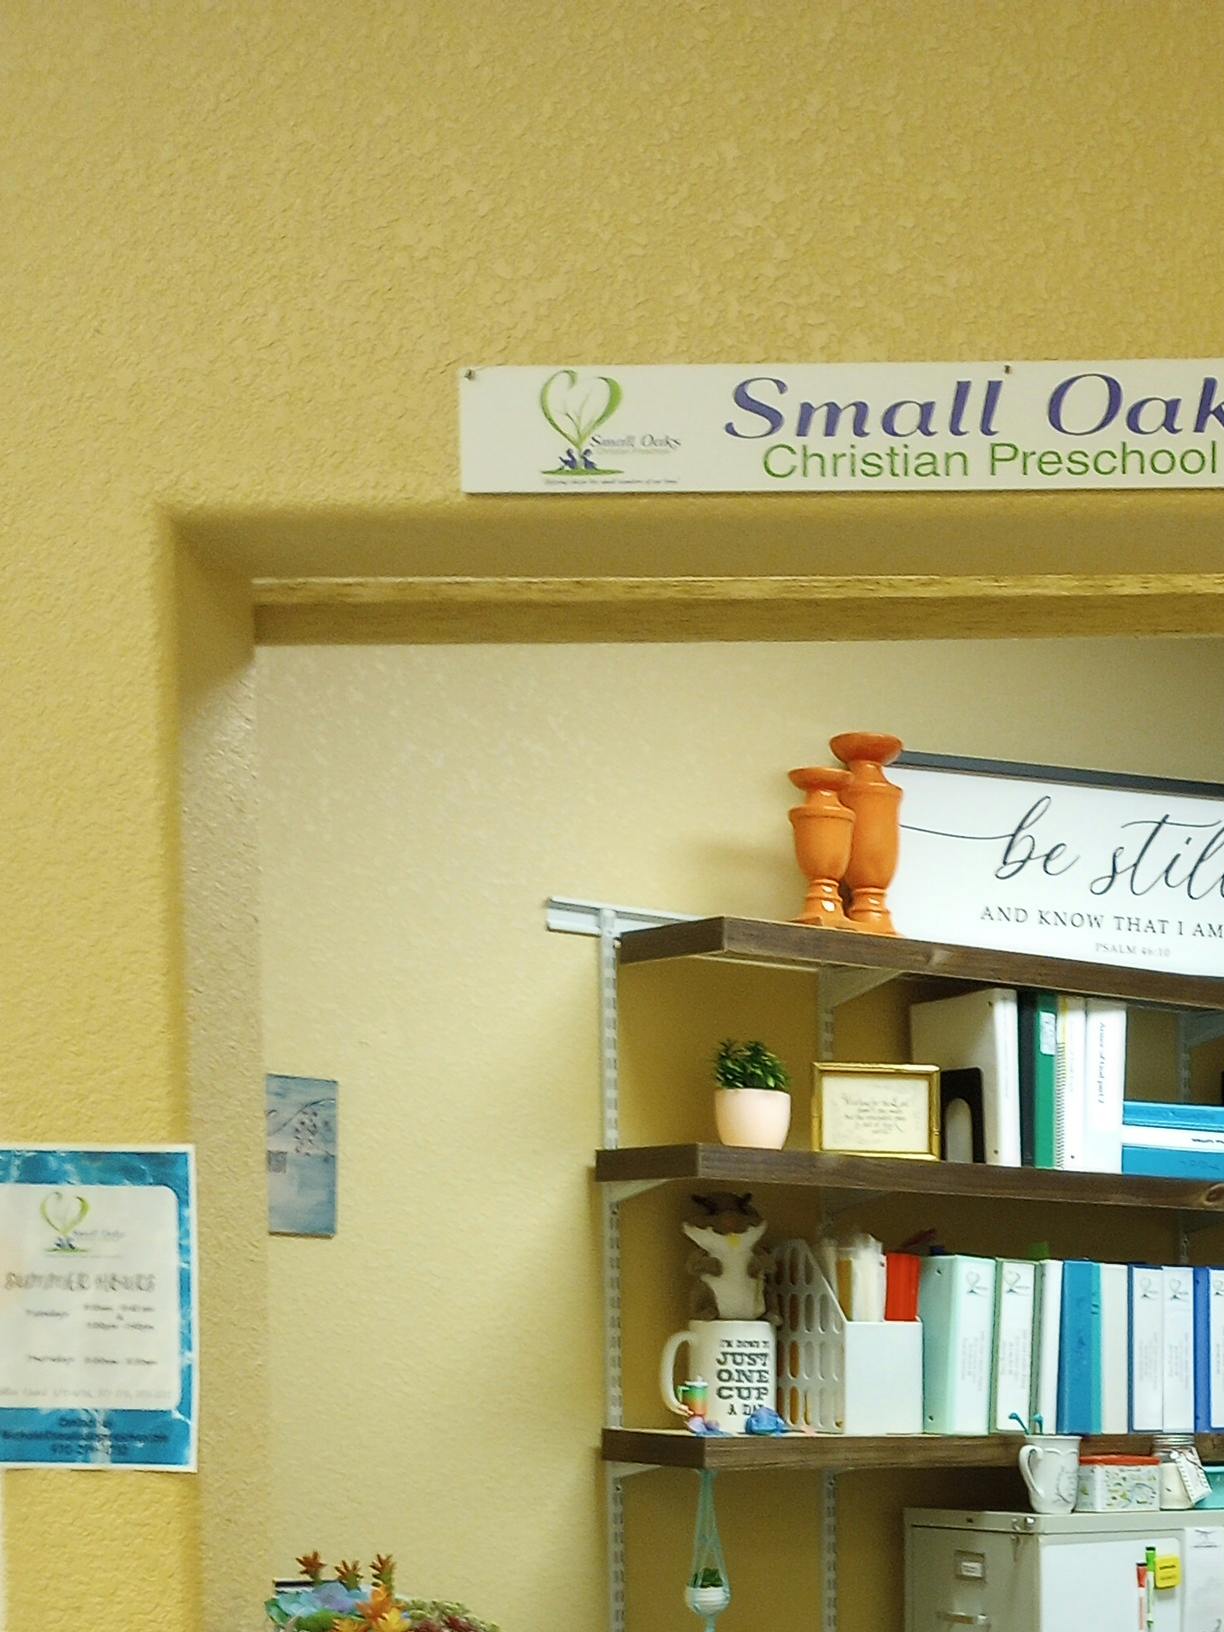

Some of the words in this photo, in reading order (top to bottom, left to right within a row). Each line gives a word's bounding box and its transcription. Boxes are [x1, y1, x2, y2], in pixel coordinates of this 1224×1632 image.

[723, 375, 1004, 440] Small
[762, 443, 970, 480] Christian
[989, 440, 1218, 477] Preschool
[980, 905, 1029, 923] AND
[1037, 908, 1106, 929] KNOW
[1113, 915, 1169, 935] THAT
[1177, 920, 1185, 936] I
[1192, 921, 1224, 939] AM
[716, 1351, 769, 1367] JUST
[716, 1368, 769, 1383] ONE
[716, 1386, 769, 1401] CUP
[727, 1403, 737, 1415] A
